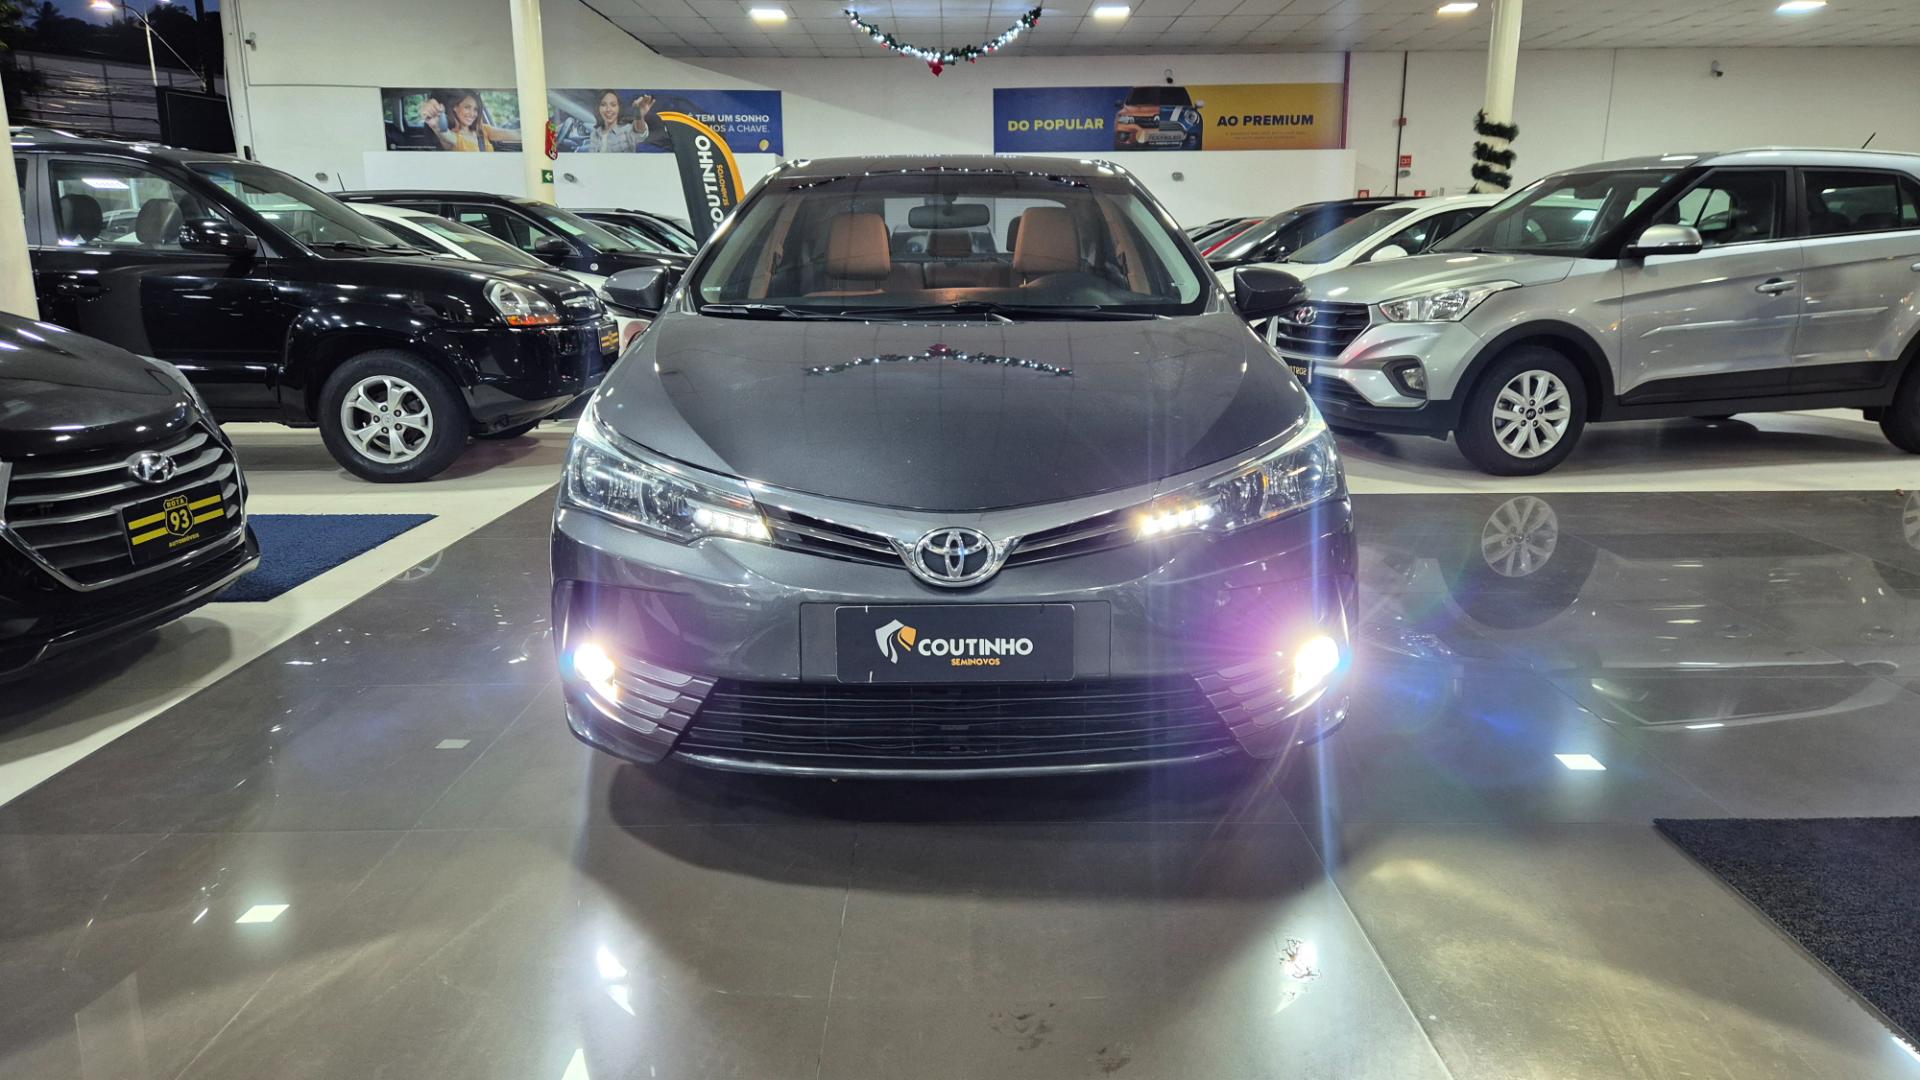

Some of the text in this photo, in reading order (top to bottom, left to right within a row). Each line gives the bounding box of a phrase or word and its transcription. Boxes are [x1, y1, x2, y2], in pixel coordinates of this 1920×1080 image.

[696, 114, 715, 122] TEM
[718, 114, 733, 122] UM
[1217, 114, 1314, 127] AO PREMIUM
[737, 125, 770, 133] CHAVE.
[1008, 118, 1104, 132] DO POPULAR
[166, 498, 185, 508] ROTA
[170, 509, 190, 531] 93
[917, 637, 1034, 657] COUTINHO
[951, 658, 1001, 666] SEMINOVOS
